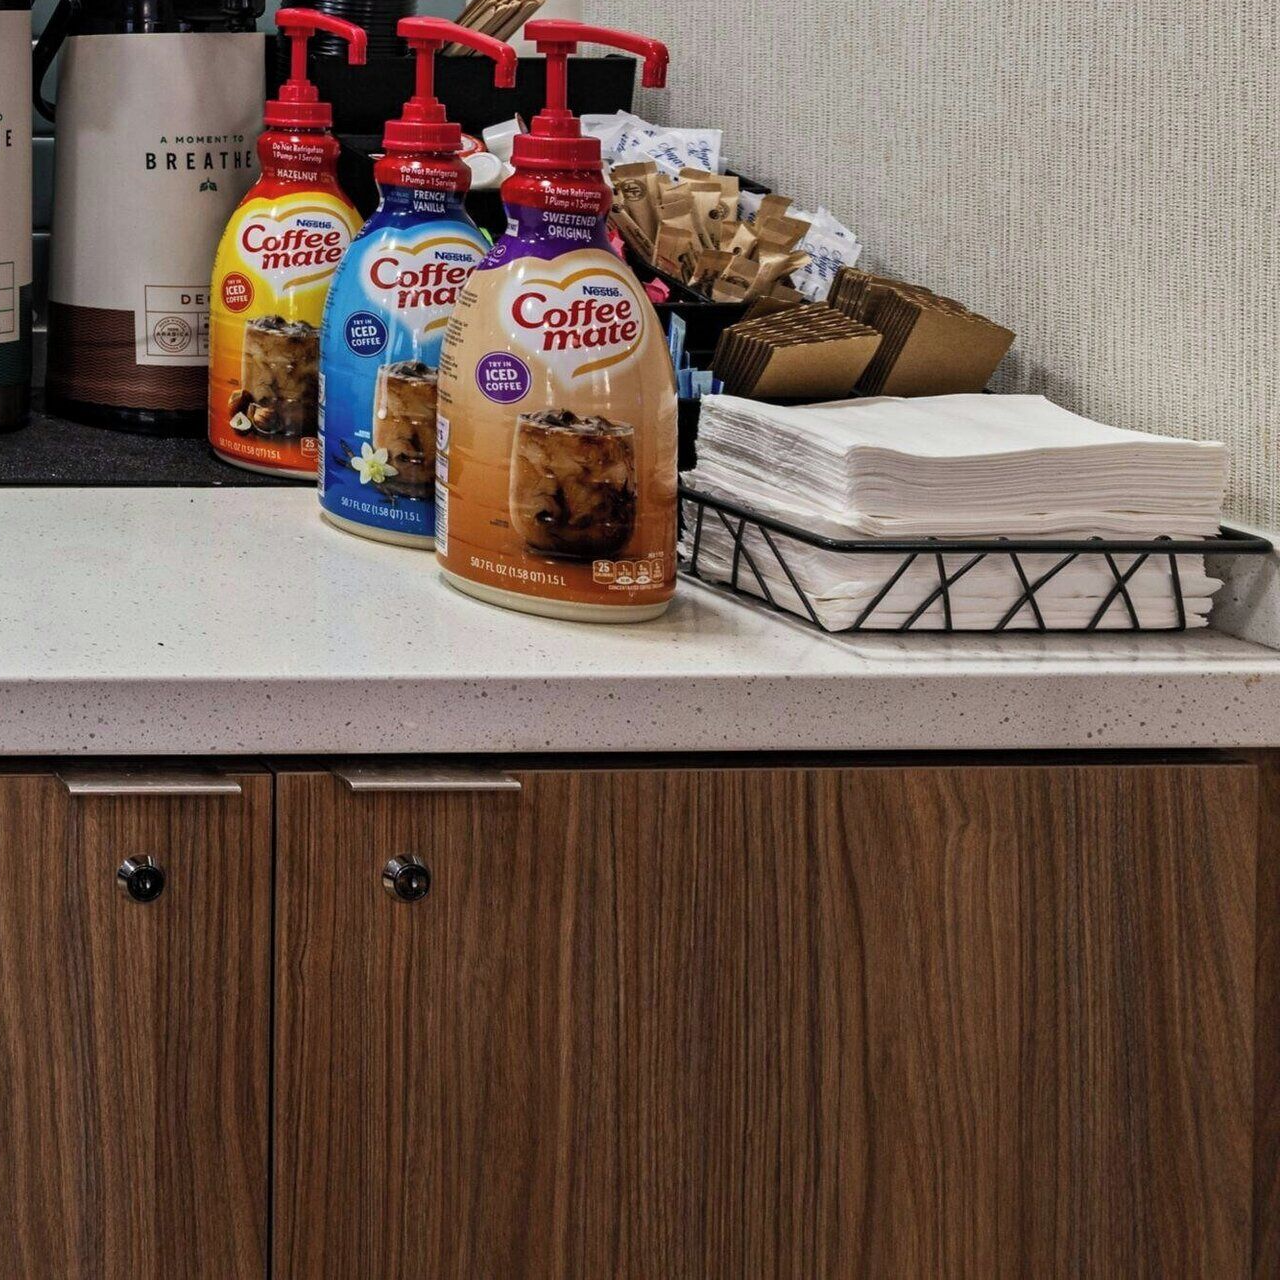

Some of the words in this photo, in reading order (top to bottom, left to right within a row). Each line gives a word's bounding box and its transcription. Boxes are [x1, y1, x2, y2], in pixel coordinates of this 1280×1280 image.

[232, 135, 244, 143] TO
[281, 143, 292, 151] Not
[145, 150, 251, 169] BREATHE
[277, 151, 293, 160] Pump
[302, 154, 321, 163] Serving
[277, 169, 317, 181] HAZELNUT
[425, 168, 458, 178] Refrigerate
[406, 175, 424, 185] Pump
[435, 179, 456, 188] Serving
[414, 190, 446, 200] FRENCH
[556, 187, 569, 196] Not
[570, 188, 601, 199] Refrigerate
[413, 201, 446, 213] VANILLA
[545, 196, 548, 204] 1
[550, 197, 569, 207] Pump
[580, 200, 600, 211] Serving
[542, 212, 596, 226] SWEETENED
[242, 225, 341, 252] Coffee
[548, 225, 592, 240] ORIGINAL
[262, 246, 342, 269] mate
[226, 285, 245, 295] ICED
[583, 286, 620, 297] Nestlé
[226, 295, 248, 303] COFFEE
[512, 292, 631, 329] Coffee
[351, 326, 377, 337] ICED
[543, 321, 637, 350] mate
[351, 338, 381, 346] COFFEE
[486, 369, 518, 381] ICED
[486, 382, 522, 391] COFFEE
[305, 440, 314, 448] 25
[353, 500, 361, 509] FL
[362, 502, 370, 512] OZ
[372, 505, 388, 517] (1.58
[390, 508, 403, 520] QT)
[404, 511, 415, 521] 1.5
[416, 513, 420, 522] L
[470, 556, 484, 568] 50.7
[486, 561, 494, 572] FL
[496, 564, 507, 575] OZ
[509, 567, 528, 580] (1.58
[530, 572, 545, 583] QT)
[548, 574, 559, 584] 1.5
[561, 577, 566, 586] L
[598, 562, 610, 572] 25
